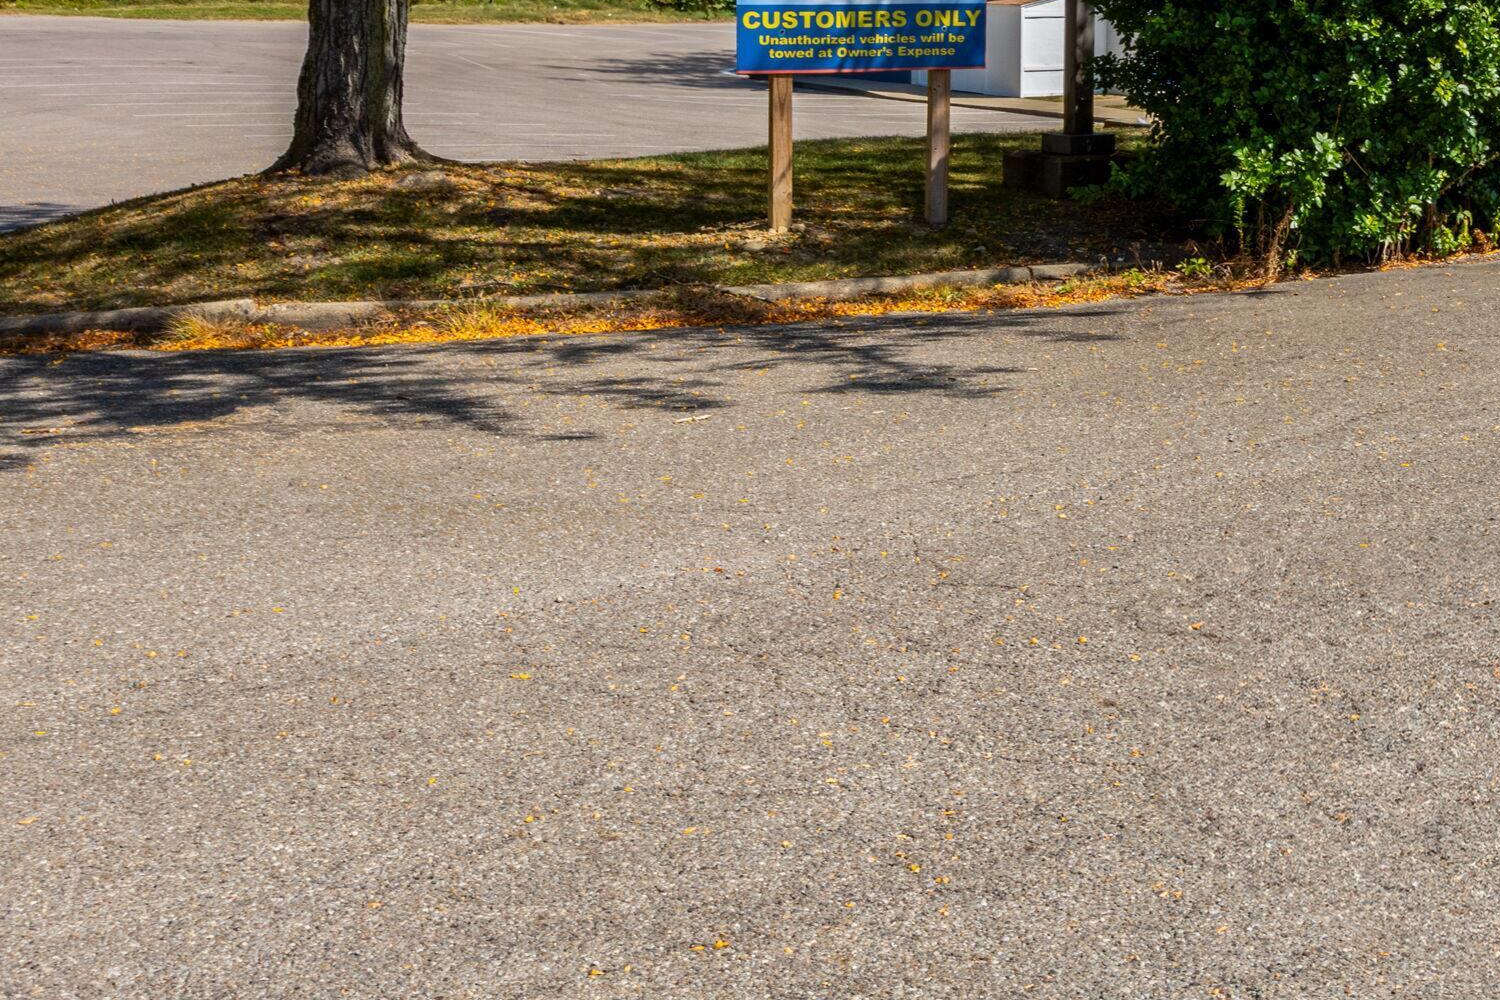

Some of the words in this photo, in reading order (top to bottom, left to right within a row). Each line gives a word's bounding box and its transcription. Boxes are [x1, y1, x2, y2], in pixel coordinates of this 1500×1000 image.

[742, 10, 907, 29] CUSTOMERS
[915, 9, 981, 27] ONLY
[759, 34, 855, 46] Unauthorized
[859, 33, 916, 44] vehicles
[920, 33, 944, 43] will
[948, 33, 965, 43] be
[769, 48, 813, 59] towed
[818, 48, 833, 58] at
[836, 46, 893, 58] Owner's
[898, 46, 956, 58] Expense
